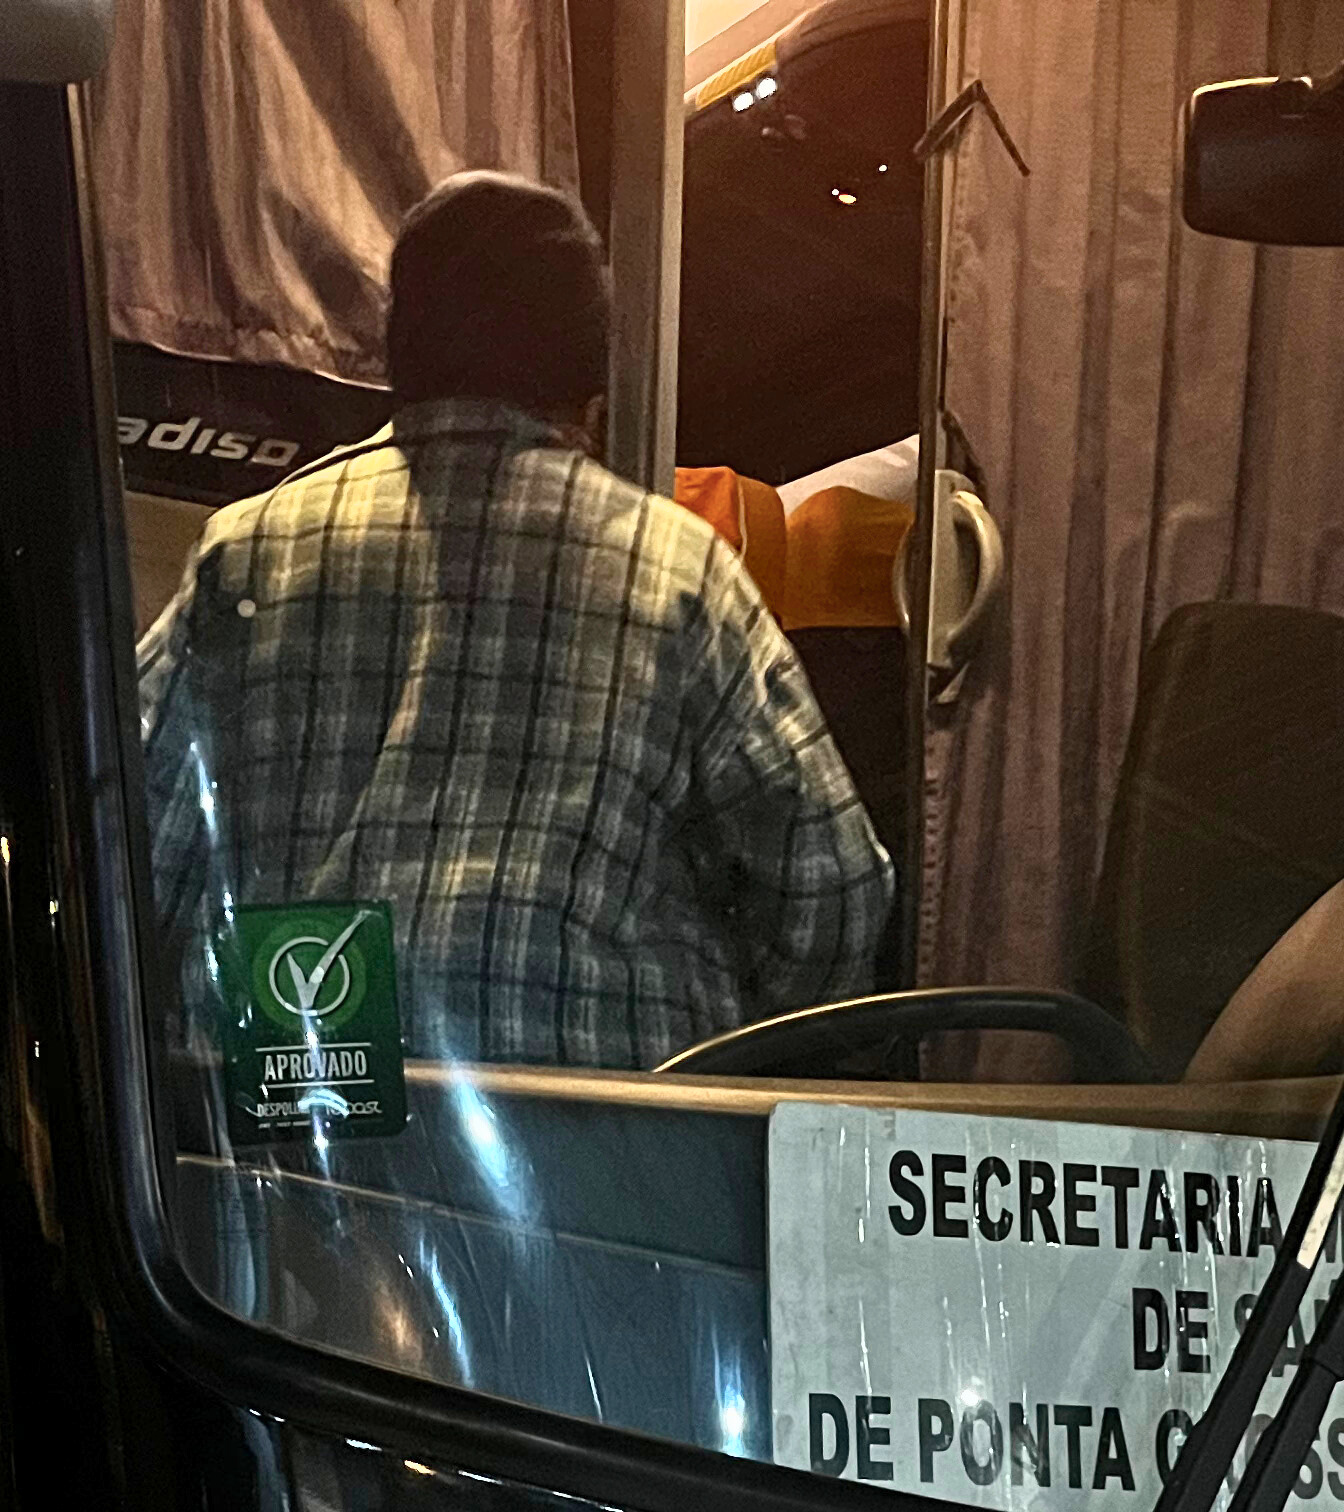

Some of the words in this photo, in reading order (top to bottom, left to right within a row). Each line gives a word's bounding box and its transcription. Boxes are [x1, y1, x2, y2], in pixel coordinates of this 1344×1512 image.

[264, 1050, 368, 1081] APROVADO
[887, 1148, 1285, 1258] SECRETARIA
[1132, 1287, 1211, 1374] DE
[808, 1392, 894, 1481] DE
[918, 1398, 1136, 1492] PONTA
